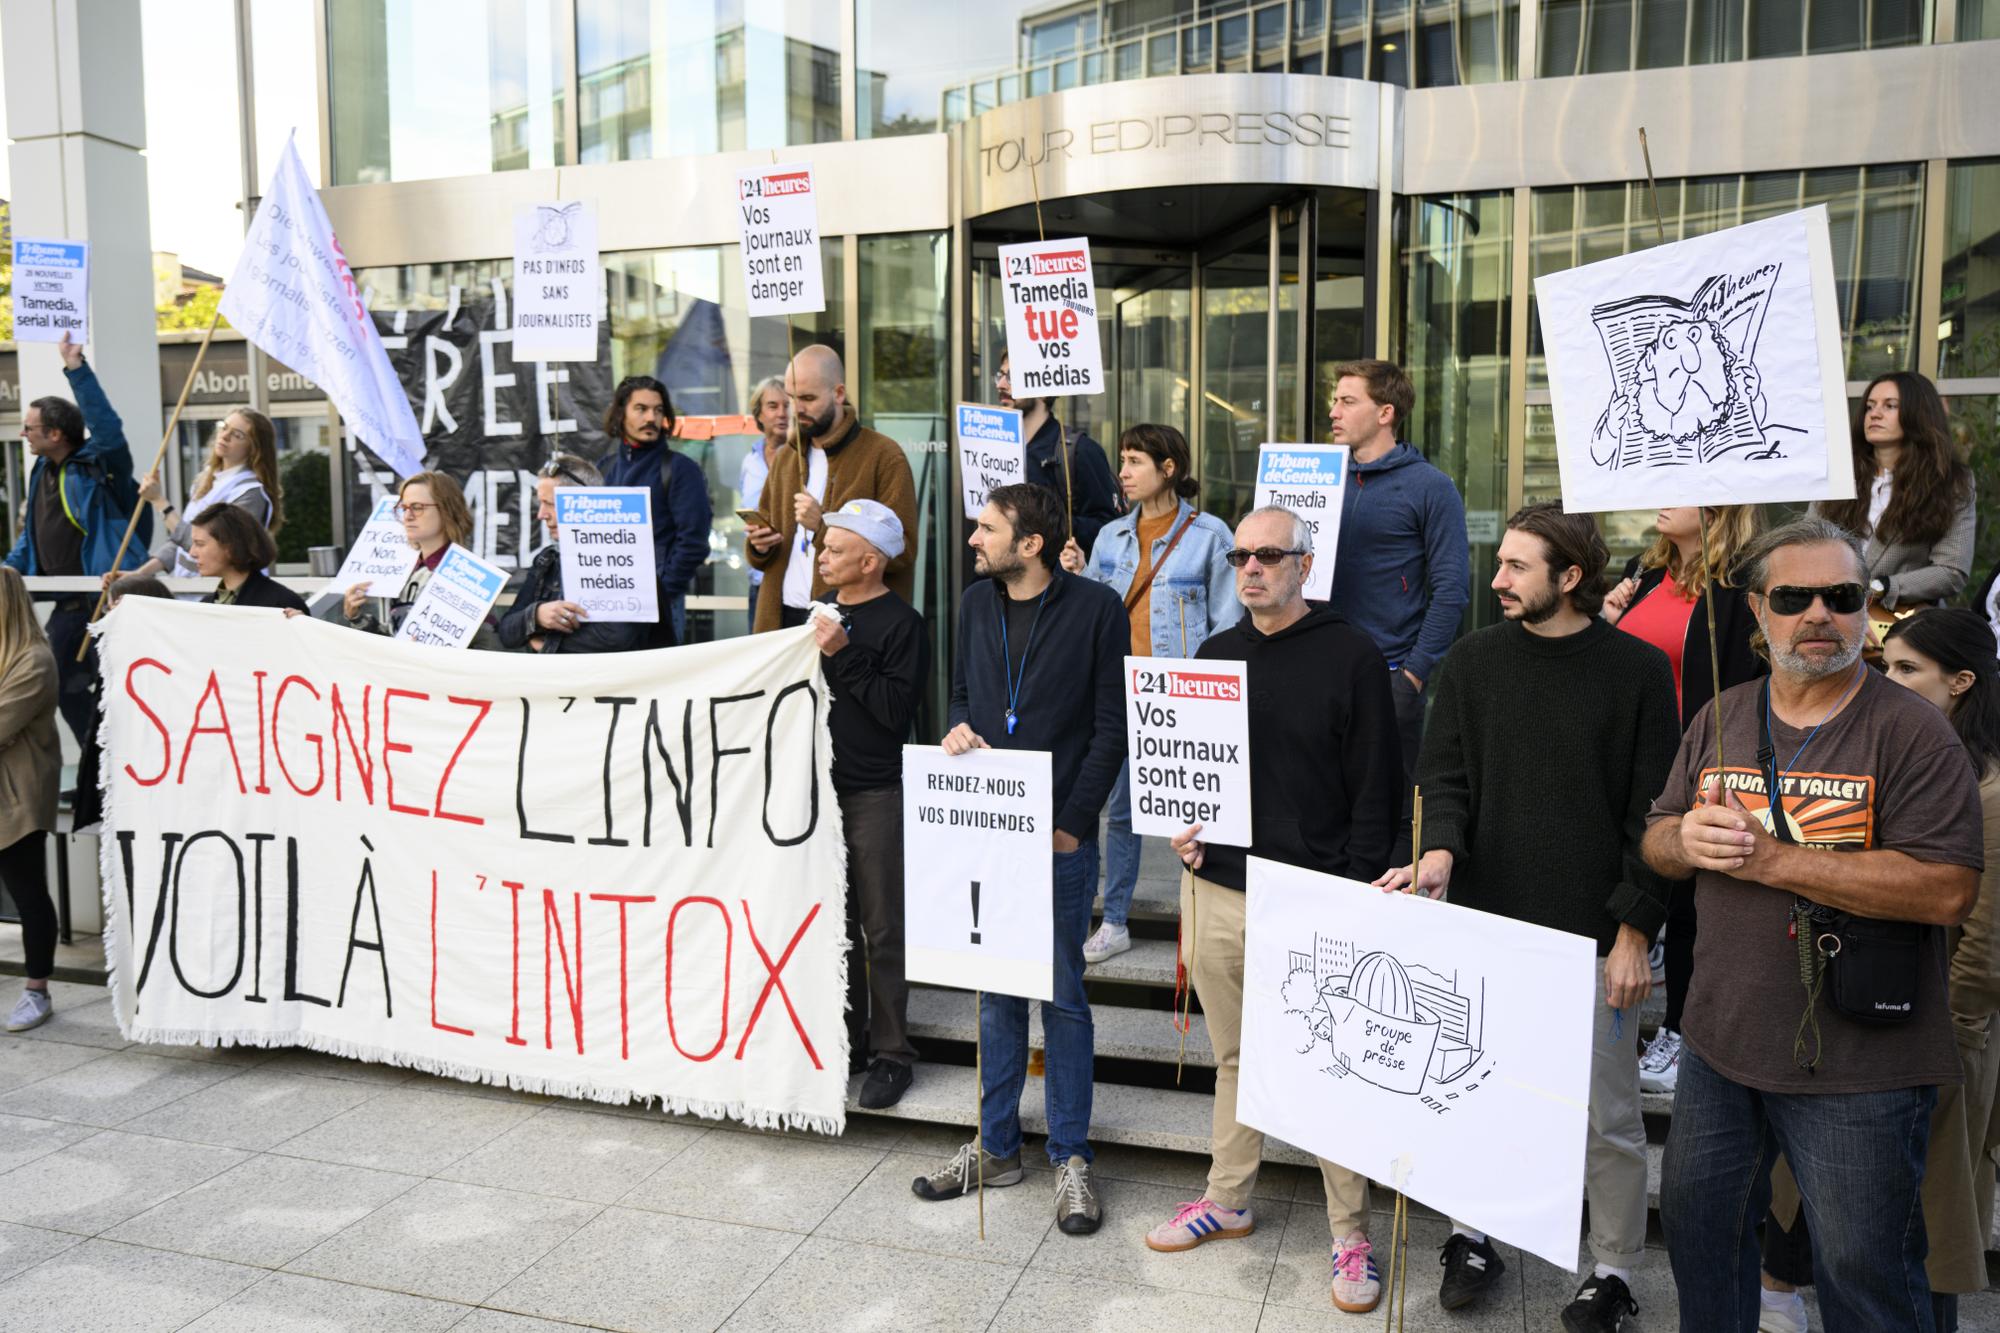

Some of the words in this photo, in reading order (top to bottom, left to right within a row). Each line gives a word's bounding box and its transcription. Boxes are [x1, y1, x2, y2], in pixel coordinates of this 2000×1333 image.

[980, 128, 1074, 176] TOUR
[1090, 111, 1351, 155] EDIPRESSE
[742, 205, 770, 225] Vos
[21, 243, 66, 257] Tribune
[745, 228, 813, 255] journaux
[523, 260, 542, 275] PAS
[546, 259, 585, 274] D'INFOS
[748, 253, 781, 275] sont
[784, 255, 802, 272] en
[34, 270, 73, 280] NOUVELLES
[34, 281, 64, 290] VICTIMES
[542, 286, 569, 300] SANS
[751, 279, 804, 301] danger
[1009, 277, 1088, 304] Tamedia
[21, 296, 78, 313] Tamedia,
[1062, 298, 1095, 317] TOUJOURS
[17, 314, 50, 328] serial
[53, 315, 83, 329] killer
[517, 313, 592, 328] JOURNALISTES
[1024, 305, 1079, 341] tue
[1038, 341, 1071, 359] vos
[1024, 364, 1091, 388] médias
[963, 409, 1003, 425] Tribune
[964, 450, 978, 467] TX
[981, 453, 1019, 475] Group?
[1267, 454, 1320, 469] Tribune
[563, 495, 622, 511] Tribune
[969, 490, 984, 507] TX
[1269, 490, 1326, 508] Tamedia
[571, 528, 636, 544] Tamedia
[578, 552, 602, 567] tue
[607, 555, 634, 567] nos
[365, 563, 409, 577] coupe!
[581, 573, 635, 589] médias
[430, 611, 466, 640] quand
[1135, 701, 1177, 728] Vos
[125, 656, 492, 826] SAIGNEZ
[516, 679, 820, 849] L'INFO
[1136, 730, 1239, 764] journaux
[927, 773, 1026, 798] RENDEZ-NOUS
[1138, 765, 1187, 789] sont
[1192, 771, 1220, 793] en
[1800, 778, 1867, 799] VALLEY
[1139, 790, 1221, 824] danger
[919, 805, 944, 824] VOS
[950, 809, 1035, 833] DIVIDENDES
[117, 830, 392, 1018] VOILÀ
[431, 869, 824, 1071] L'INTOX
[1875, 1002, 1901, 1010] lafuma
[1365, 1020, 1412, 1046] groupe
[1380, 1041, 1395, 1056] de
[1363, 1049, 1405, 1071] presse
